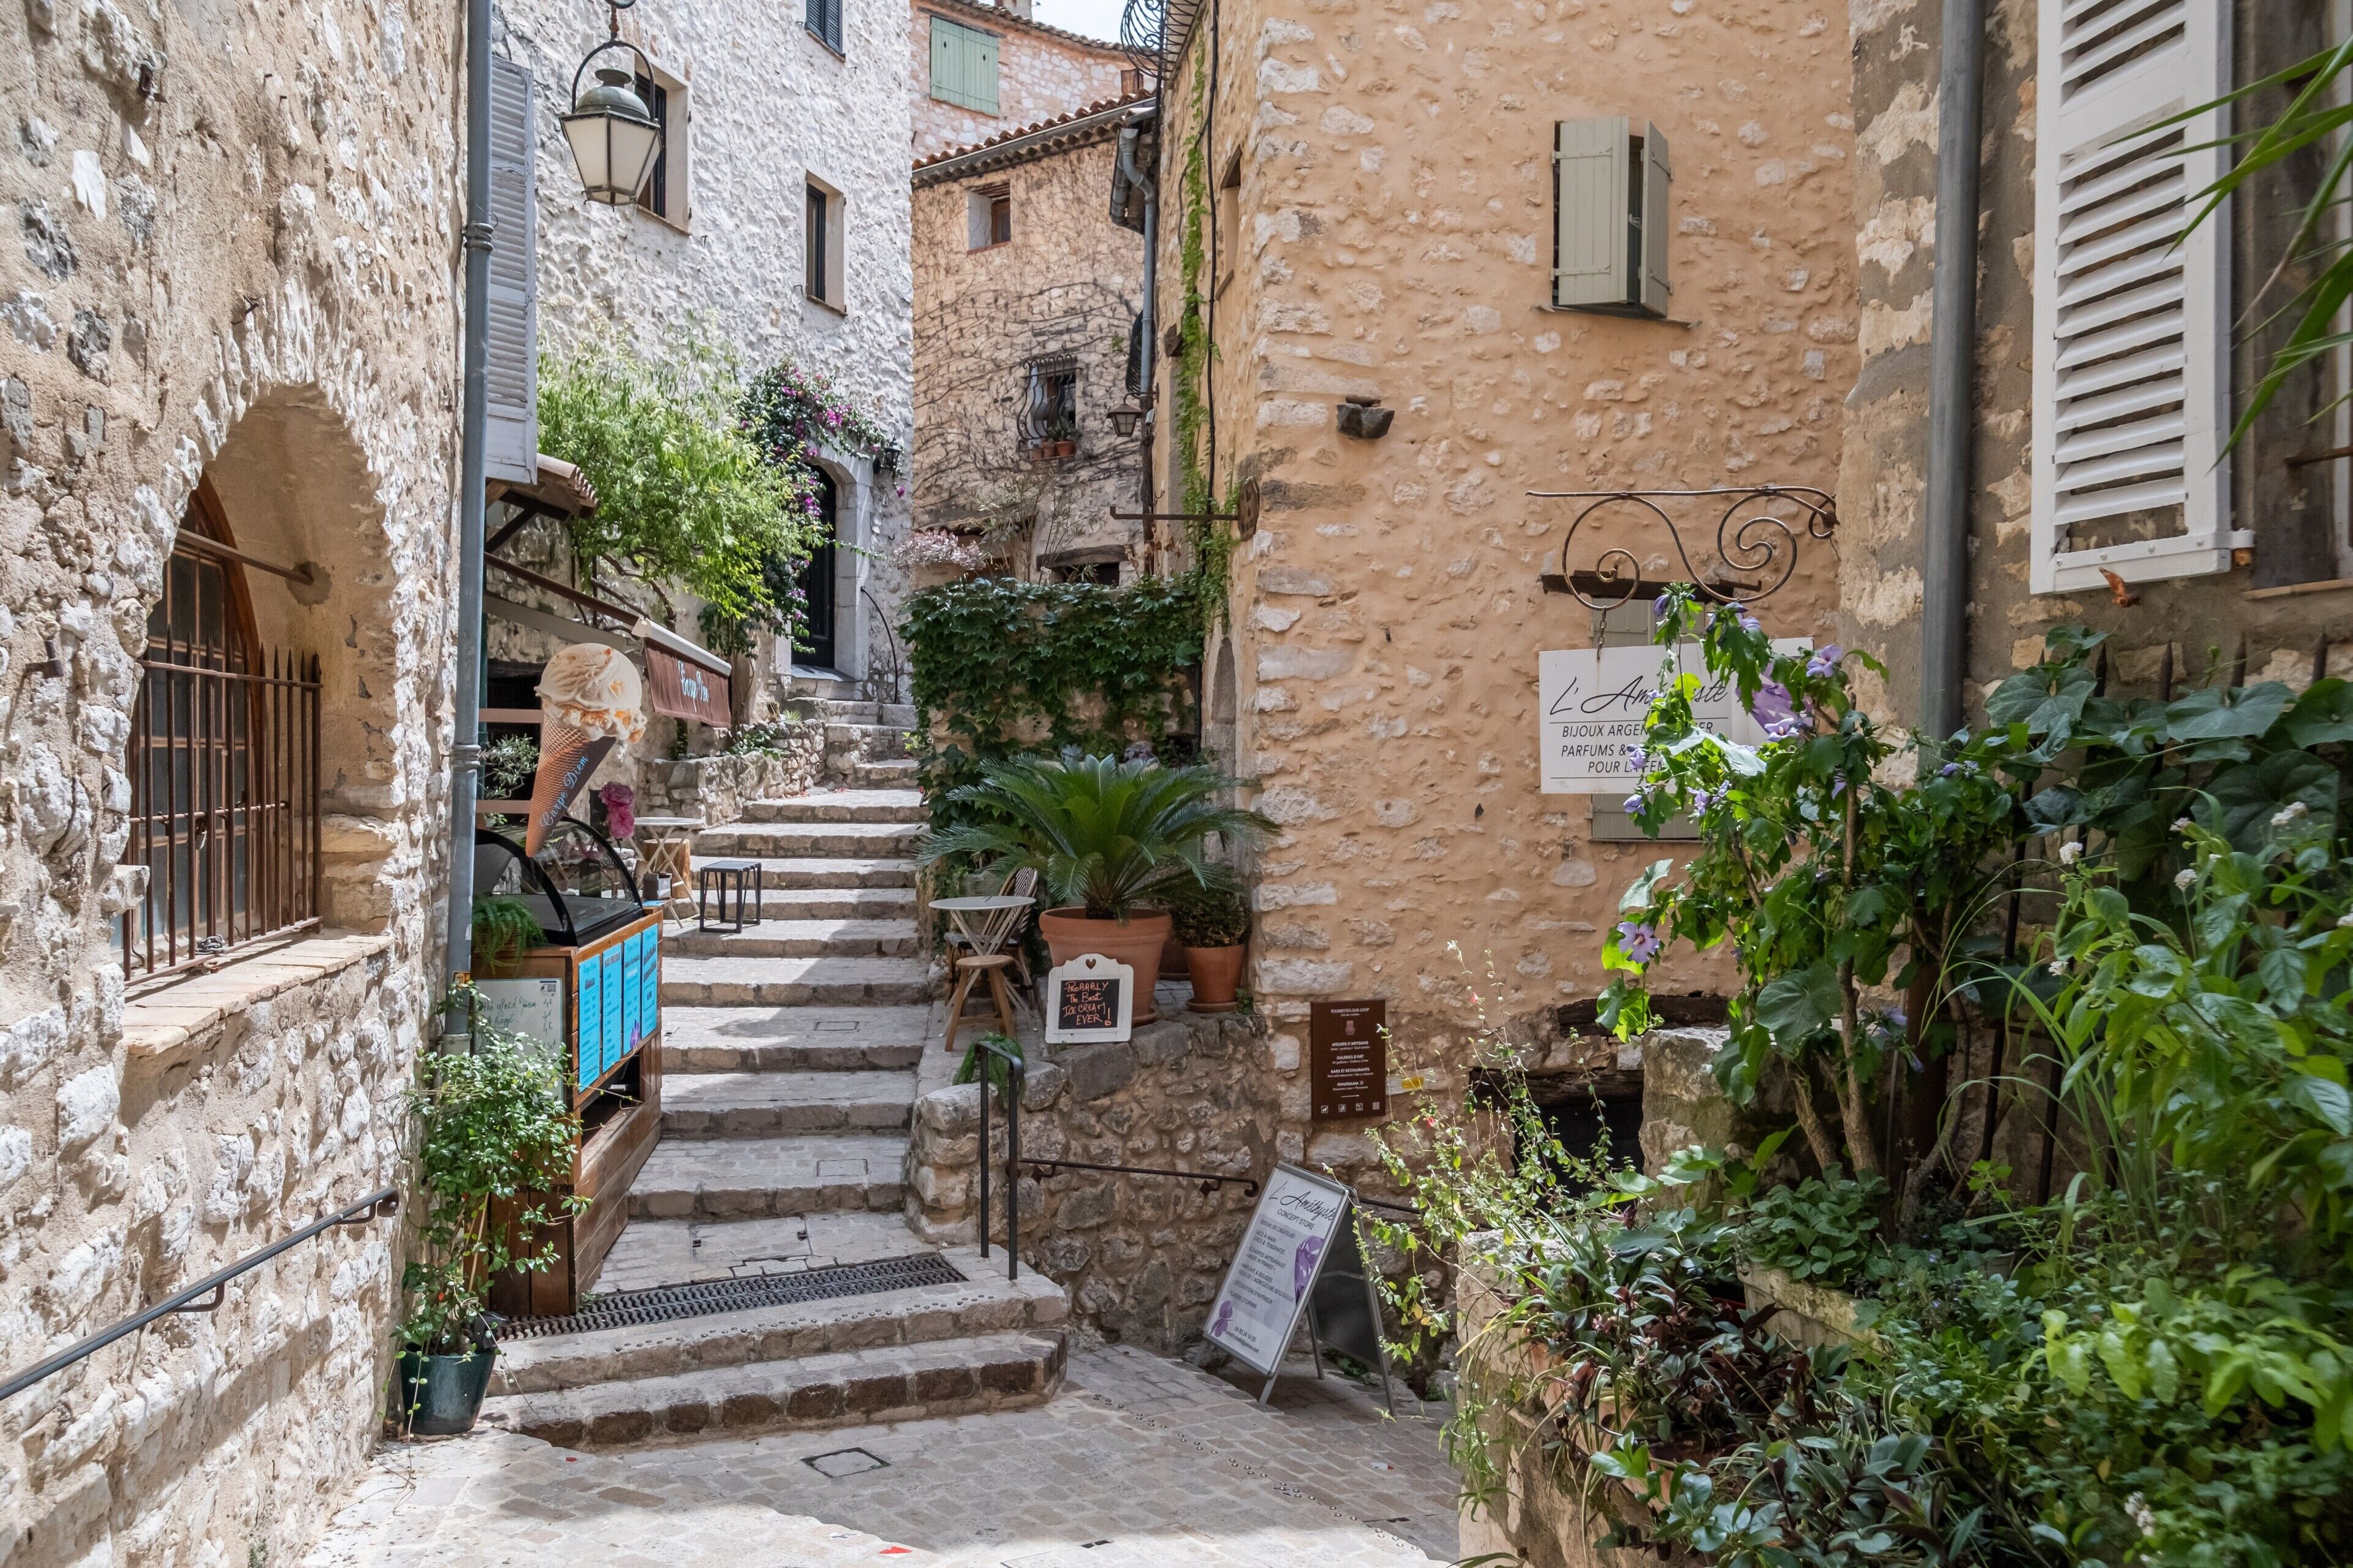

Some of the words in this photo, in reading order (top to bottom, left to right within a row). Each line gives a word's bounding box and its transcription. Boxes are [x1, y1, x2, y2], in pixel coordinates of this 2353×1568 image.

[1563, 725, 1604, 737] BIJOUX
[1561, 744, 1615, 757] PARFUMS
[1619, 744, 1626, 756] &
[1588, 761, 1620, 773] POUR
[539, 791, 568, 827] Carpe
[564, 755, 588, 789] Diem
[1066, 994, 1078, 1003] The
[1082, 991, 1103, 1002] Best
[1062, 1005, 1076, 1017] ICE
[1078, 1002, 1105, 1014] CREAM
[1277, 1208, 1300, 1223] CONCEPT
[1298, 1218, 1315, 1230] STORE
[1265, 1241, 1285, 1254] TENDANCES
